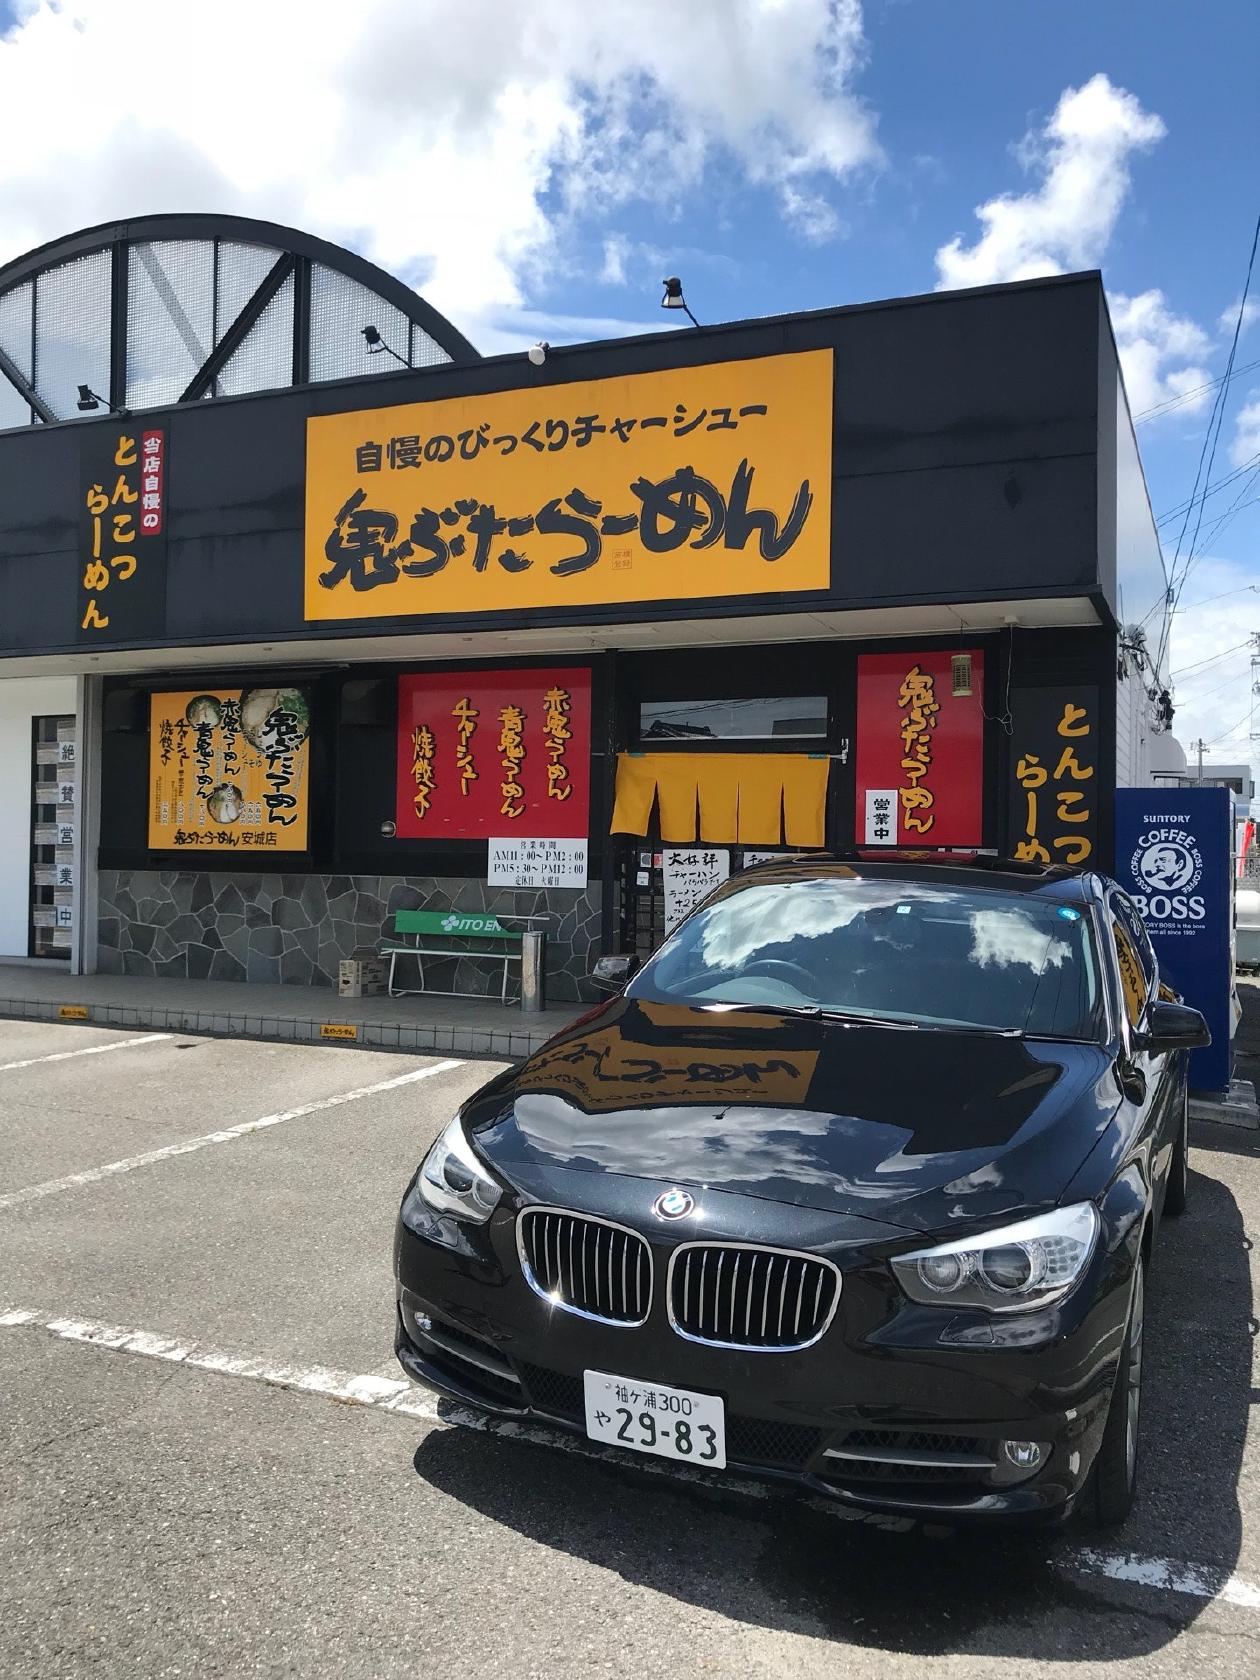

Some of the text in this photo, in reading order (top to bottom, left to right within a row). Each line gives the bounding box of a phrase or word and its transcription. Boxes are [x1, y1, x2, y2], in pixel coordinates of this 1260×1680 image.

[356, 404, 768, 474] 自慢のびっくりチャーシュー
[110, 436, 138, 580] とんこつ
[143, 437, 161, 527] 当店自慢の
[318, 457, 813, 592] 鬼ぶたらーめん
[81, 483, 110, 629] らーめん
[193, 721, 215, 800] 青鬼らーめん
[220, 698, 242, 776] 赤鬼らーめん
[262, 706, 304, 826] 鬼ぶたらーめん
[451, 697, 480, 796] チャーシュー
[497, 705, 528, 818] 青鬼らーめん
[543, 685, 574, 801] 赤鬼らーめん
[897, 665, 940, 834] 鬼ぶたらーめん
[411, 724, 438, 818] 焼餃子
[1053, 703, 1094, 864] とんこつ
[60, 744, 75, 924] 絶賛営業中
[241, 832, 277, 846] 安城店
[520, 841, 557, 850] 営業時間
[873, 798, 890, 840] 営業中
[1138, 828, 1196, 849] COFFEE
[1143, 815, 1191, 823] SUNTORY
[515, 875, 560, 886] 定休日 火曜日
[668, 852, 718, 870] 大好評
[669, 871, 720, 879] チャーハン
[1130, 848, 1153, 894] BOSS COFFEE
[1181, 848, 1203, 894] BOSS COFFEE
[669, 889, 702, 898] ラーメン
[675, 899, 702, 907] +25
[1130, 895, 1206, 920] BOSS
[458, 919, 483, 931] ITO
[594, 1407, 717, 1460] や 29-83
